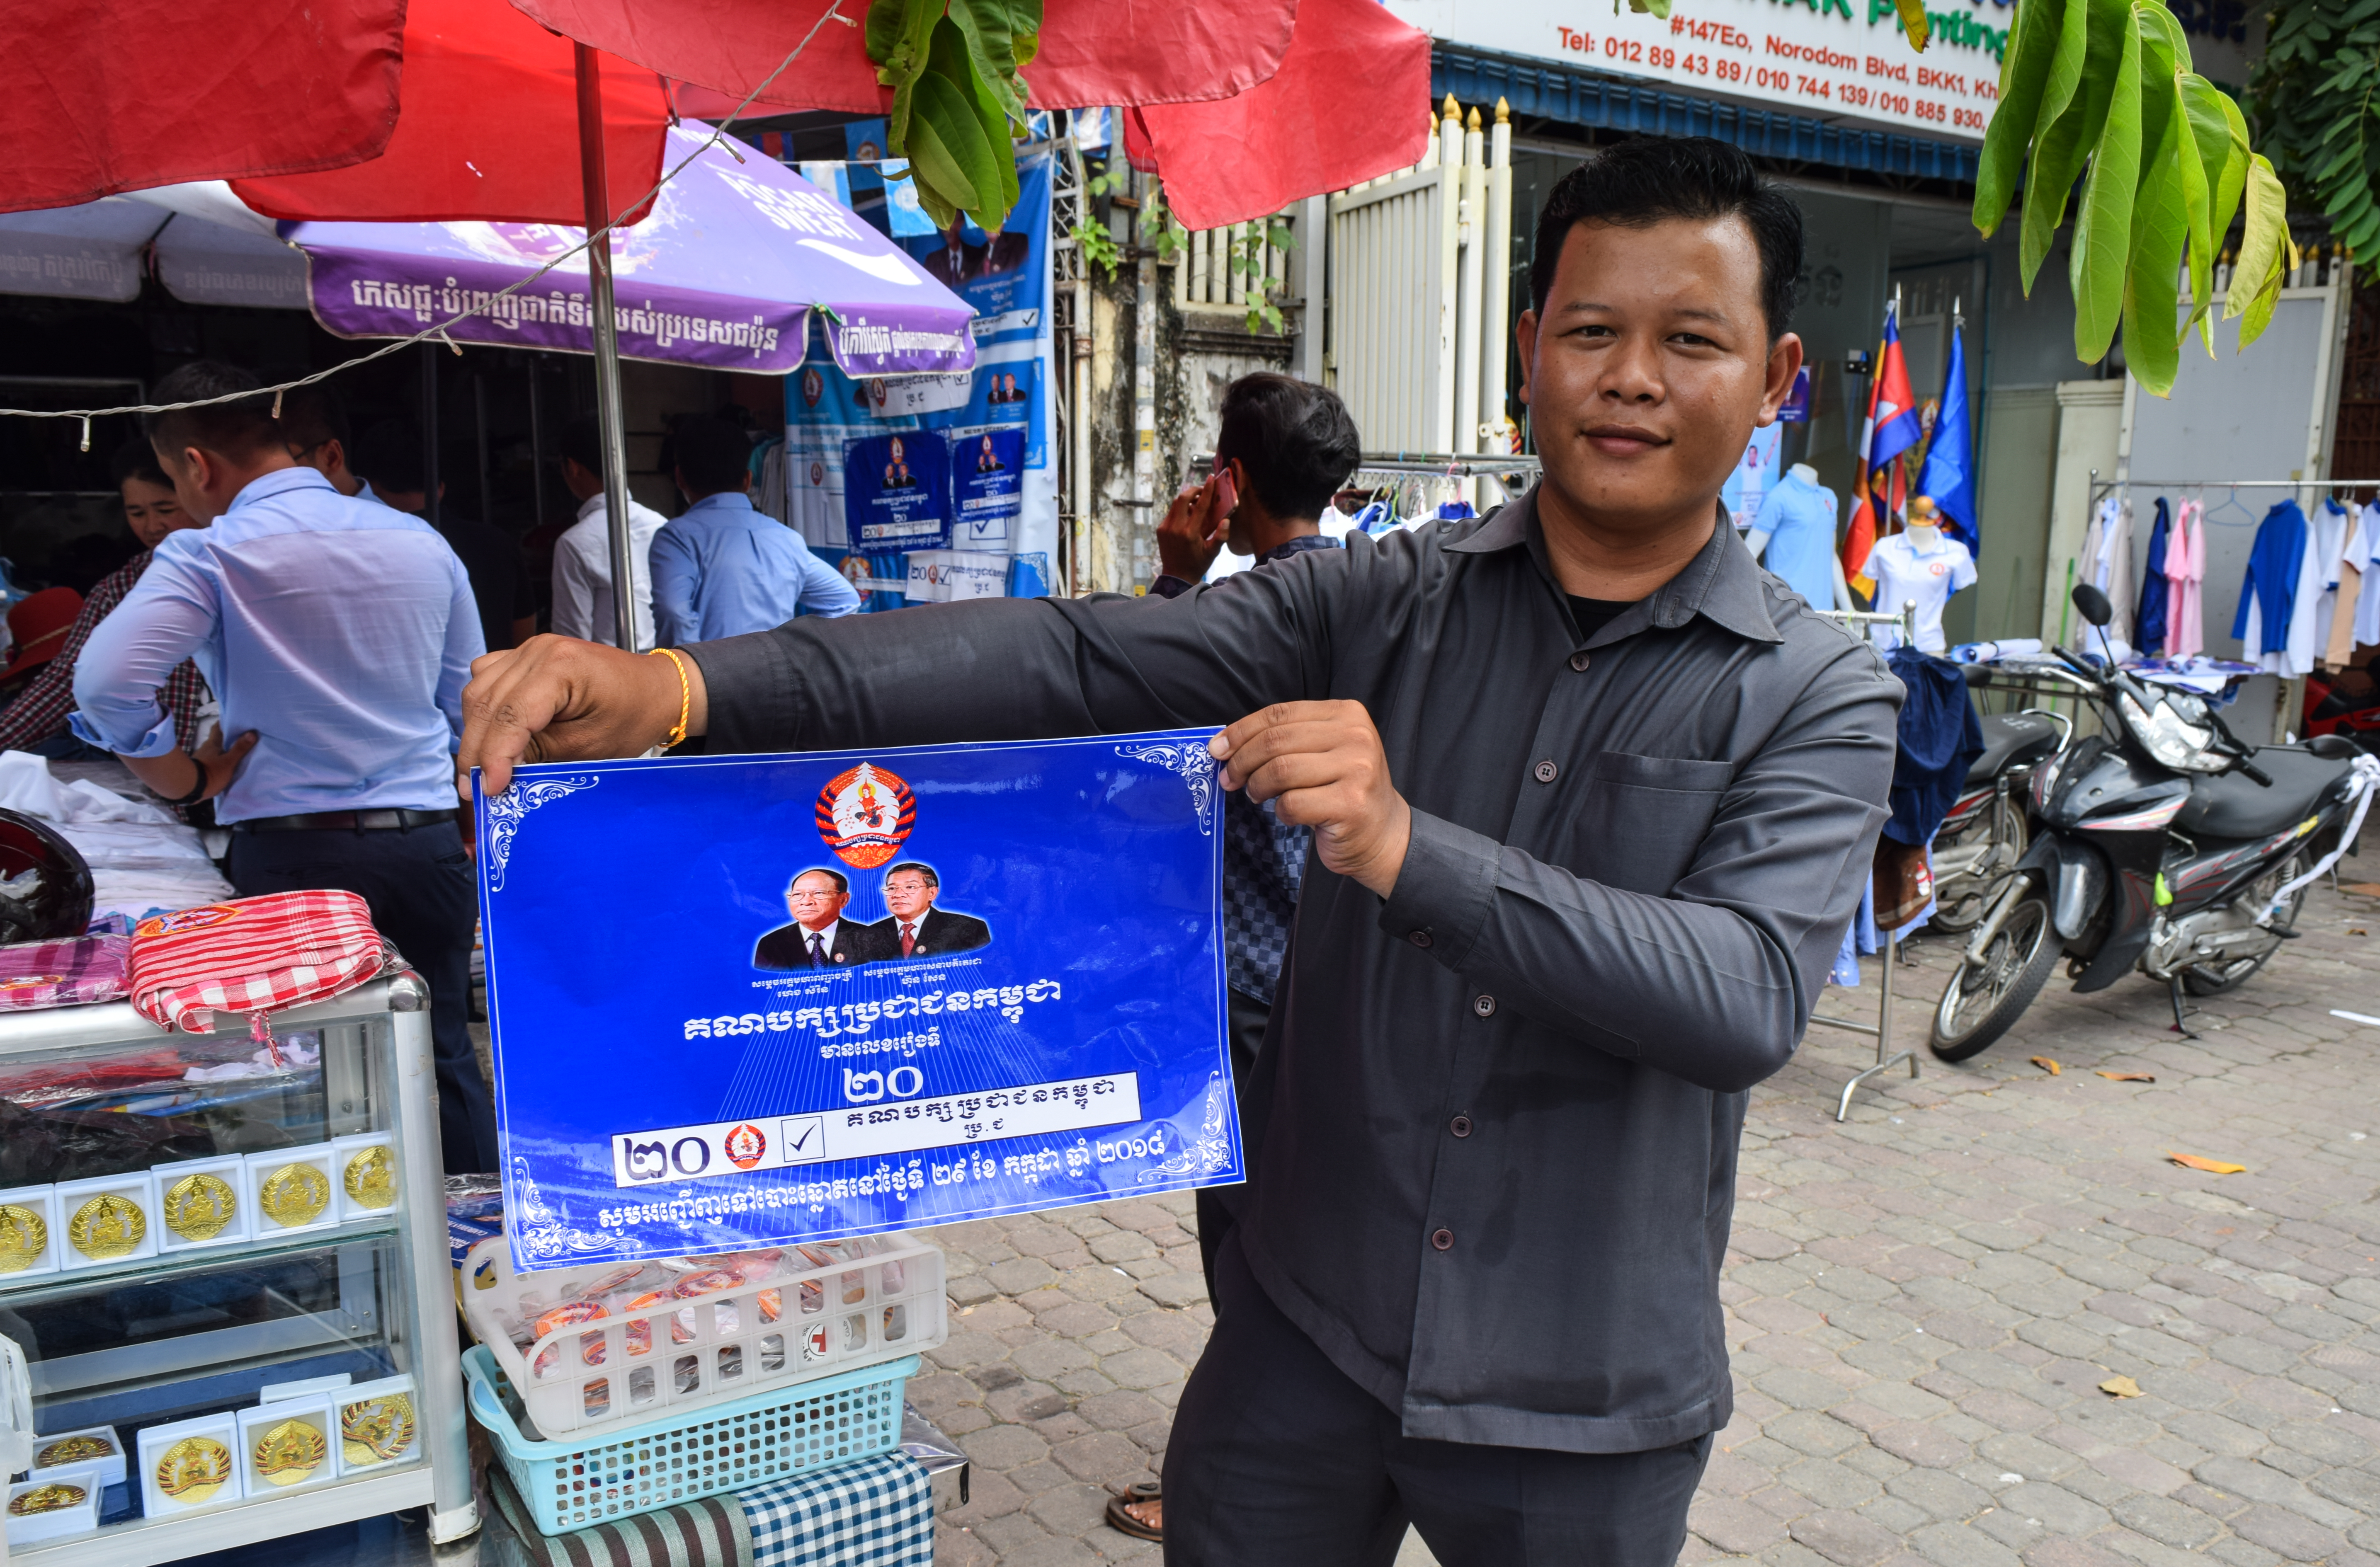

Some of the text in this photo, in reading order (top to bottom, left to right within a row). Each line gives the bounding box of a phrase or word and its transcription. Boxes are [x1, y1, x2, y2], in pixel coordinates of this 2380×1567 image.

[1558, 27, 1595, 52] Tel:
[1606, 37, 1641, 62] 012
[1650, 45, 1675, 68] 89
[1683, 54, 1708, 75] 43
[1717, 59, 1741, 81] 89
[1757, 68, 1789, 90] 010
[1798, 75, 1830, 99] 744
[1839, 84, 1867, 105] 139
[1880, 92, 1909, 114] 010
[1915, 100, 1946, 122] 885
[1953, 108, 1986, 132] 930,
[1671, 15, 1998, 100] #147Eo, Norodom Blvd, BKK1, Kh
[717, 172, 844, 217] POCARI
[753, 200, 864, 241] SWEAT
[924, 972, 946, 983] សែន
[684, 978, 1062, 1039] គណបក្សប្រជាជនកម្ពុជា
[821, 1026, 940, 1058] មានលេខរៀងទី
[843, 1066, 924, 1103] ២០
[623, 1136, 711, 1181] ២០
[931, 1158, 967, 1186] ២៩
[971, 1150, 996, 1181] ខែ
[1004, 1147, 1059, 1184] កក្កដា
[1067, 1138, 1090, 1177] ឆ្នាំ
[1097, 1129, 1165, 1163] ២០១៨
